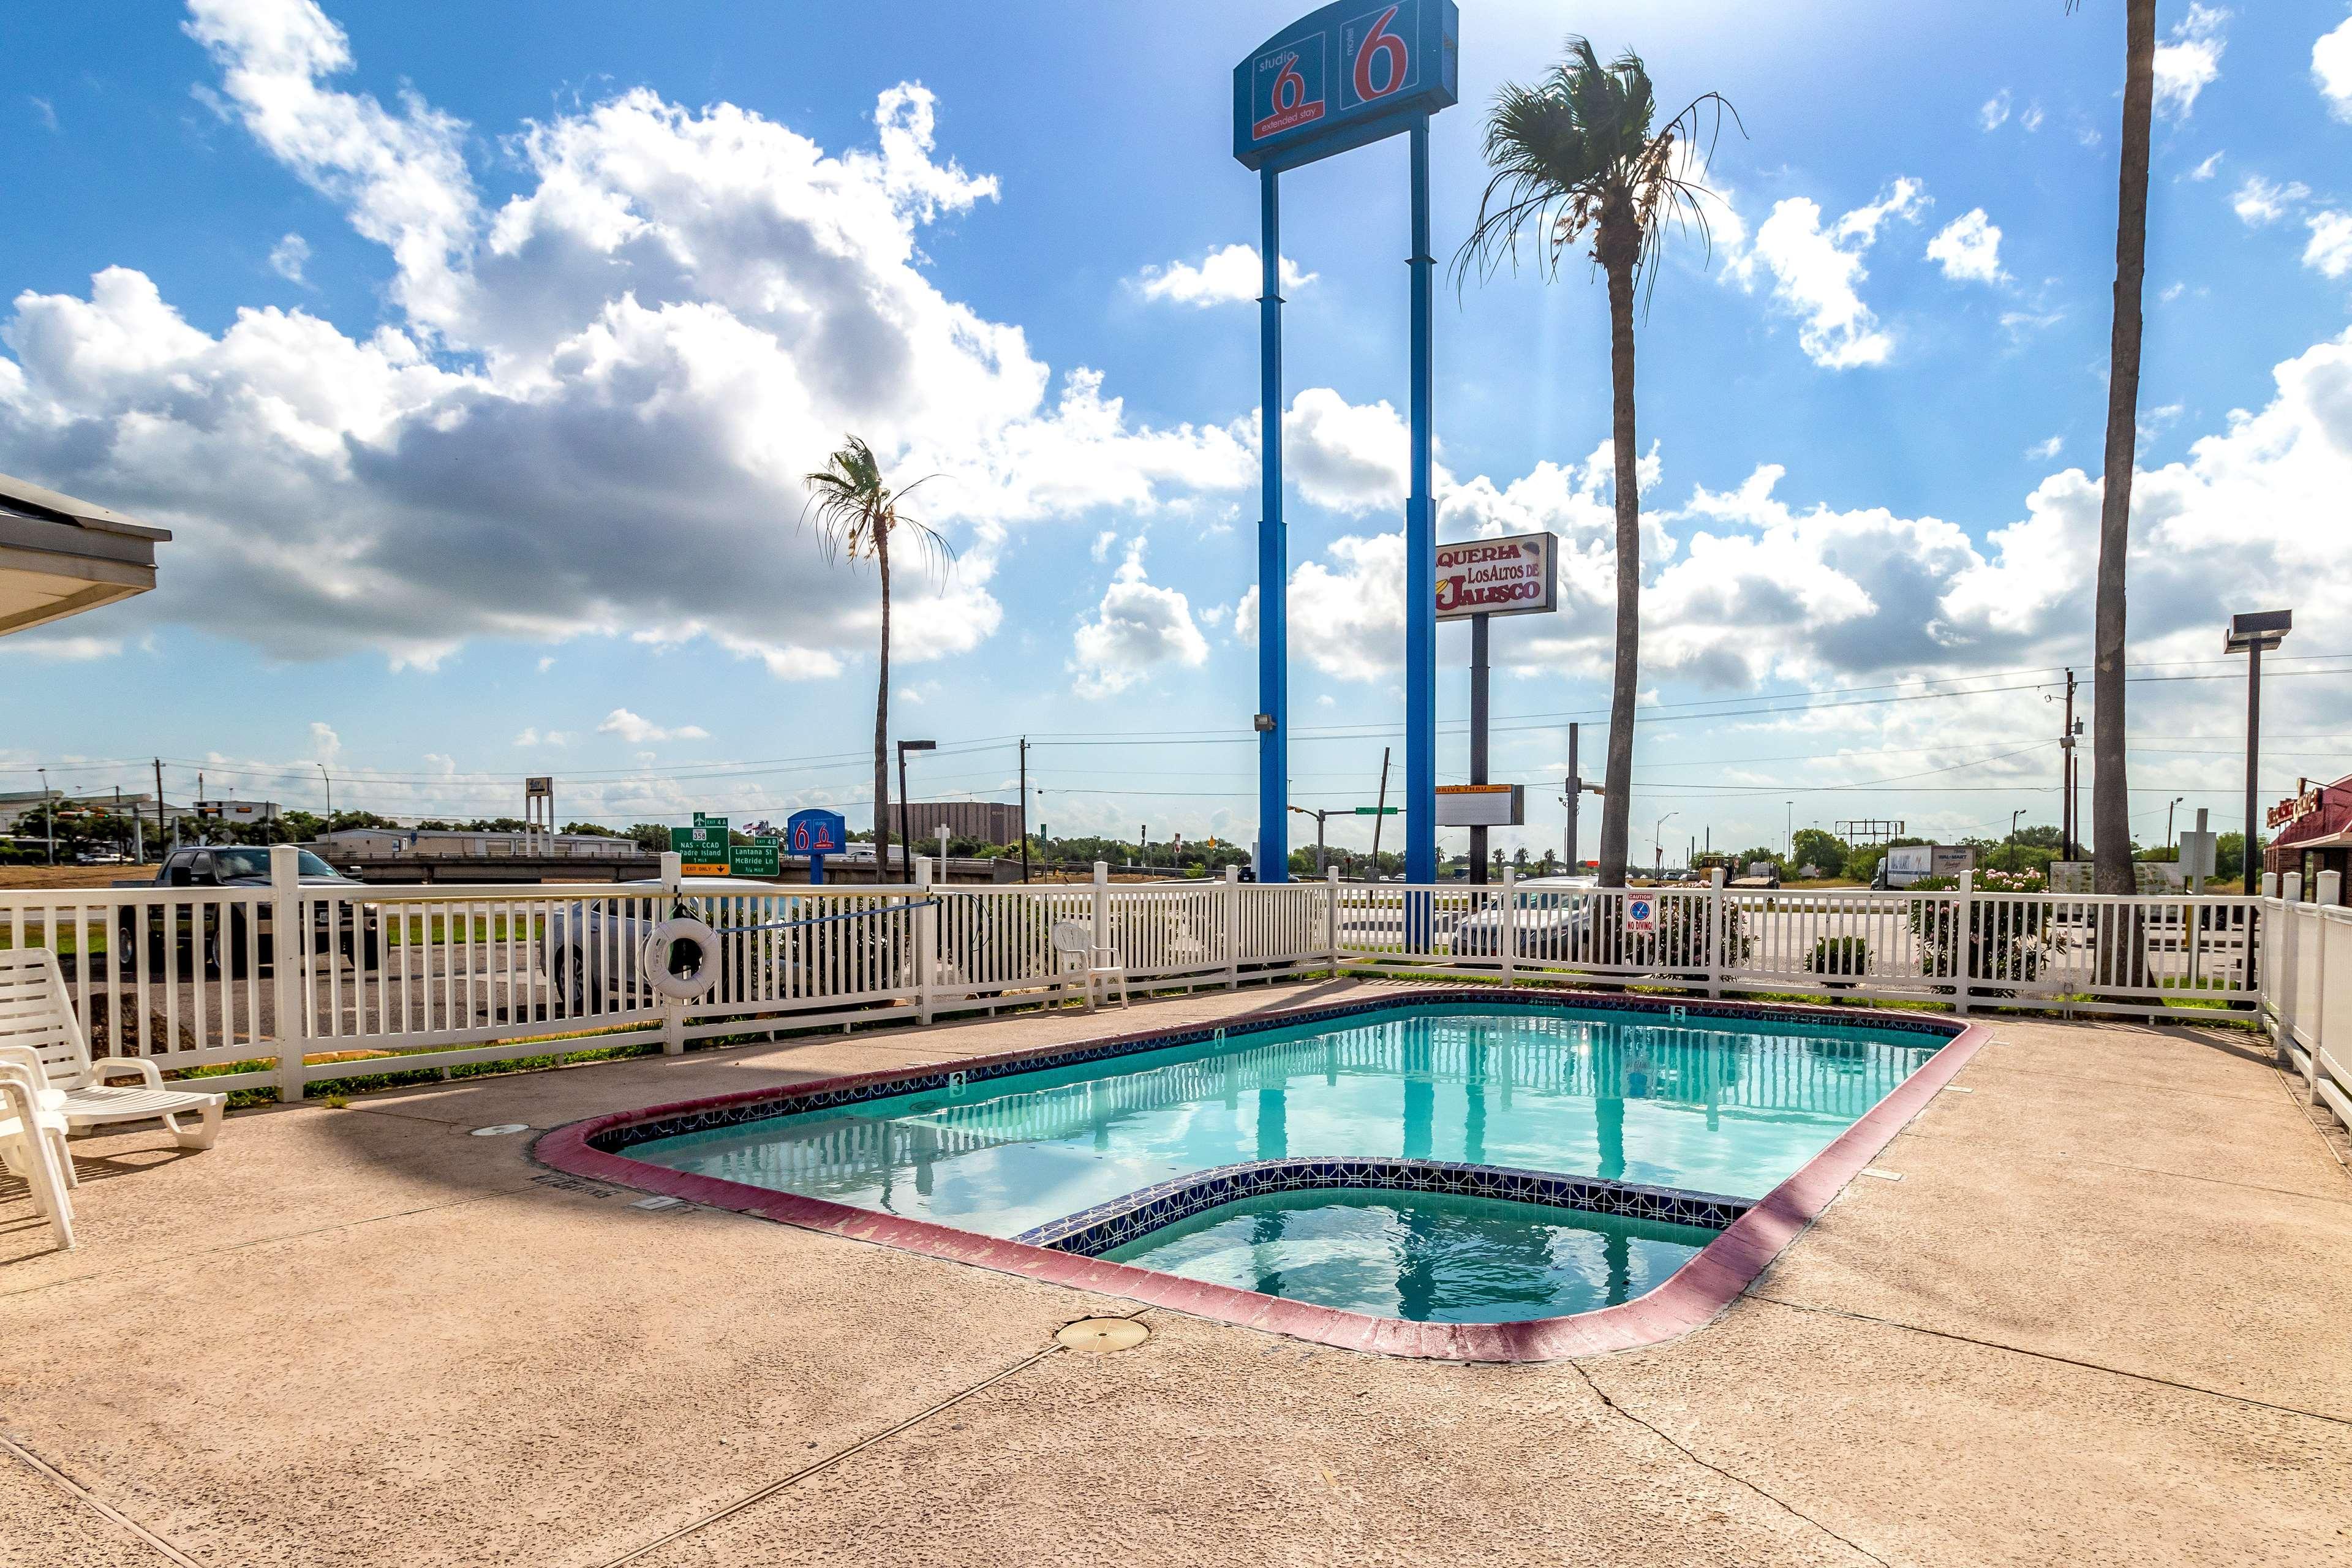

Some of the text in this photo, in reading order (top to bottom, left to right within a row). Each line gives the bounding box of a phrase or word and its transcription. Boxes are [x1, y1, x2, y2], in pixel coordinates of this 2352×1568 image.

[1259, 51, 1295, 72] studio
[1352, 6, 1408, 102] 6
[1272, 54, 1305, 115] 6
[1262, 108, 1317, 131] extended stay
[1435, 545, 1521, 568] QUERIA
[1526, 564, 1539, 577] DE
[1436, 575, 1540, 610] JALISCO
[795, 820, 809, 850] 6
[1627, 921, 1653, 930] NO DIVING!
[1673, 1006, 1683, 1020] 5
